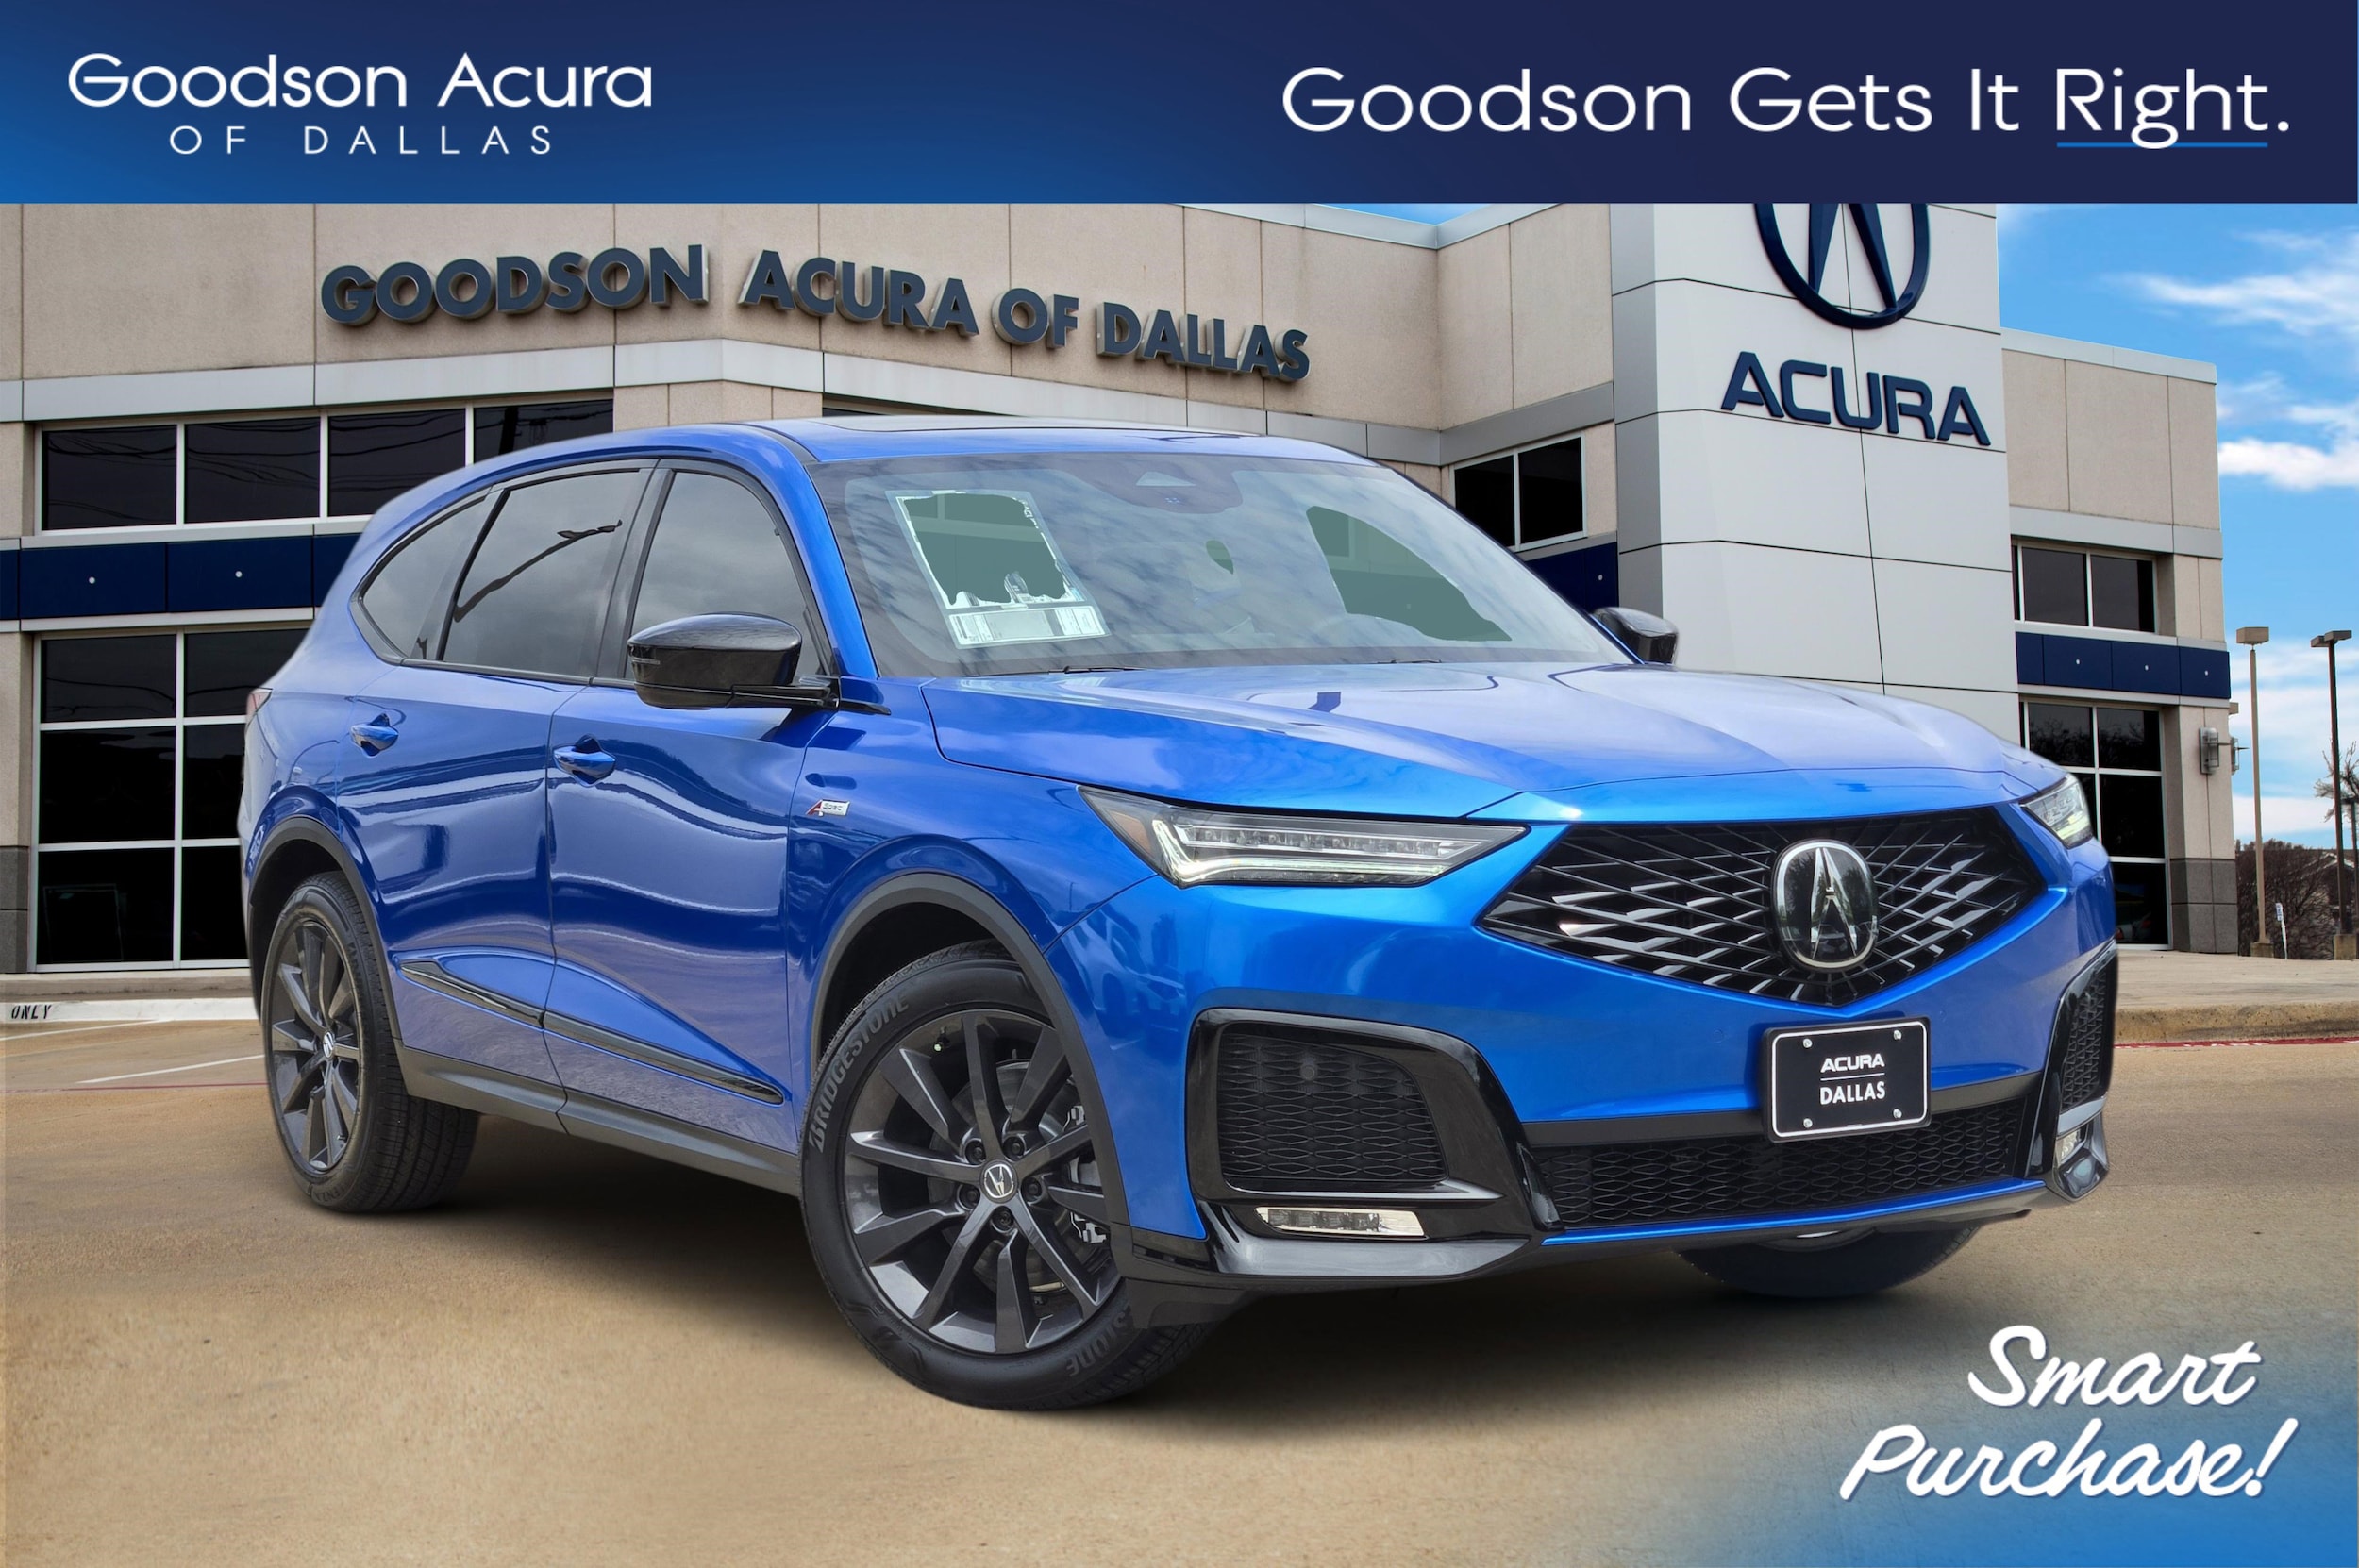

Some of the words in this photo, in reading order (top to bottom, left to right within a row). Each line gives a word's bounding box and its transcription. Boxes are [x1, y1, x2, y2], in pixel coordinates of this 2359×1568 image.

[321, 244, 709, 326] GOODSON
[739, 249, 979, 338] ACURA
[992, 287, 1079, 348] OF
[1096, 301, 1311, 382] DALLAS
[1721, 351, 1991, 447] ACURA
[11, 1004, 52, 1019] ONLY
[809, 994, 910, 1153] BRIDGESTONE
[1819, 1080, 1886, 1105] DALLAS
[1820, 1053, 1885, 1074] ACURA
